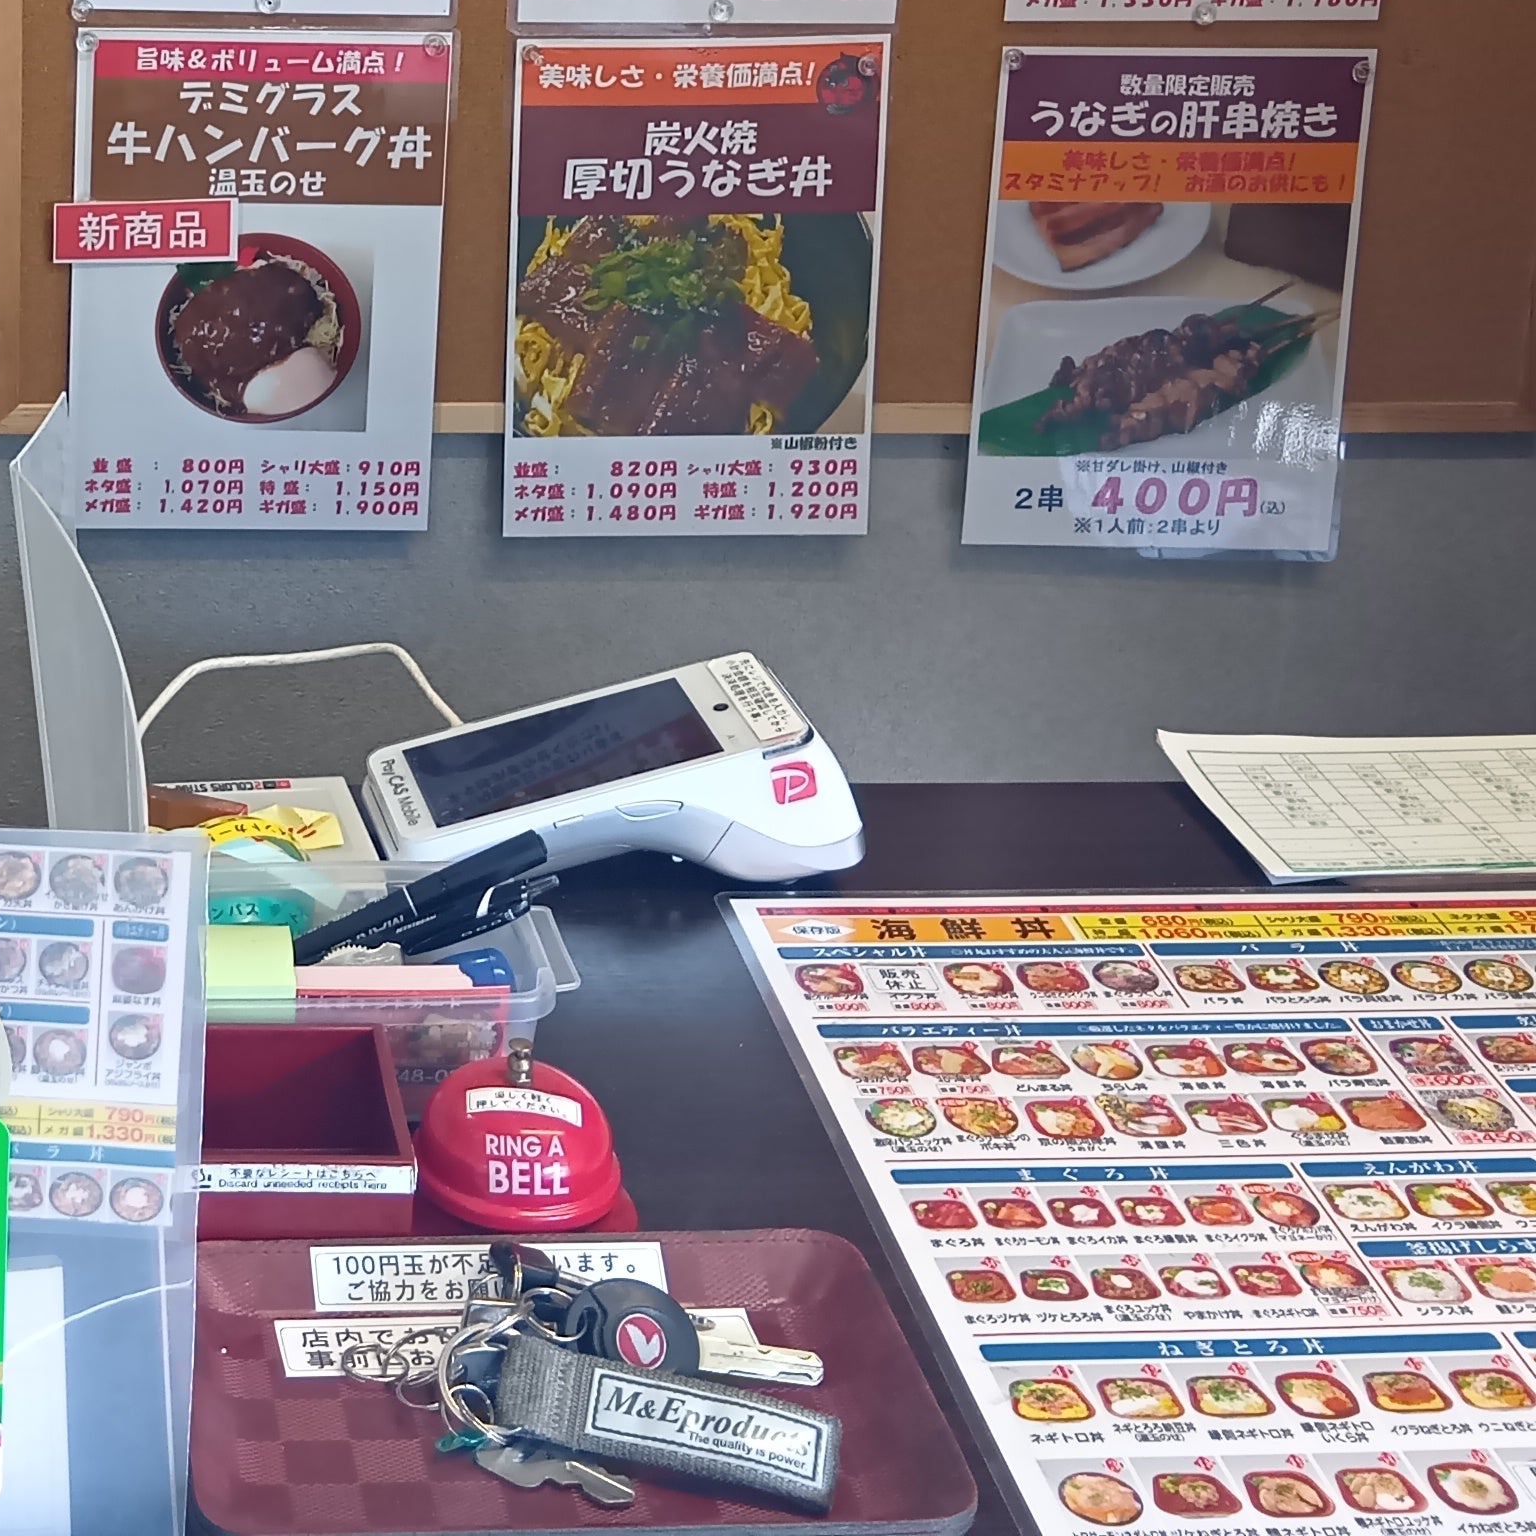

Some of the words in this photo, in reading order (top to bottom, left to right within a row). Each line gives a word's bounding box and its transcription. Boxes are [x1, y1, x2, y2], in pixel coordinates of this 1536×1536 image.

[179, 81, 363, 117] デミグラス
[1120, 74, 1255, 96] 数量限定販売
[1029, 100, 1338, 140] うなぎの肝串焼き
[107, 121, 432, 170] 牛ハンバーグ丼
[644, 119, 758, 156] 炭火焼
[208, 169, 328, 197] 温玉のせ
[564, 156, 833, 200] 厚切うなぎ丼
[78, 210, 207, 252] 新商品
[1014, 483, 1063, 513] 2串
[1091, 477, 1259, 517] 400円
[871, 917, 1056, 941] 海鮮丼
[879, 969, 921, 980] 販売
[883, 979, 926, 991] 休止
[485, 1134, 541, 1157] RING
[542, 1136, 565, 1157] A
[218, 1179, 258, 1189] Discard
[488, 1161, 570, 1196] BELL
[687, 1432, 710, 1445] The
[712, 1438, 753, 1455] quality
